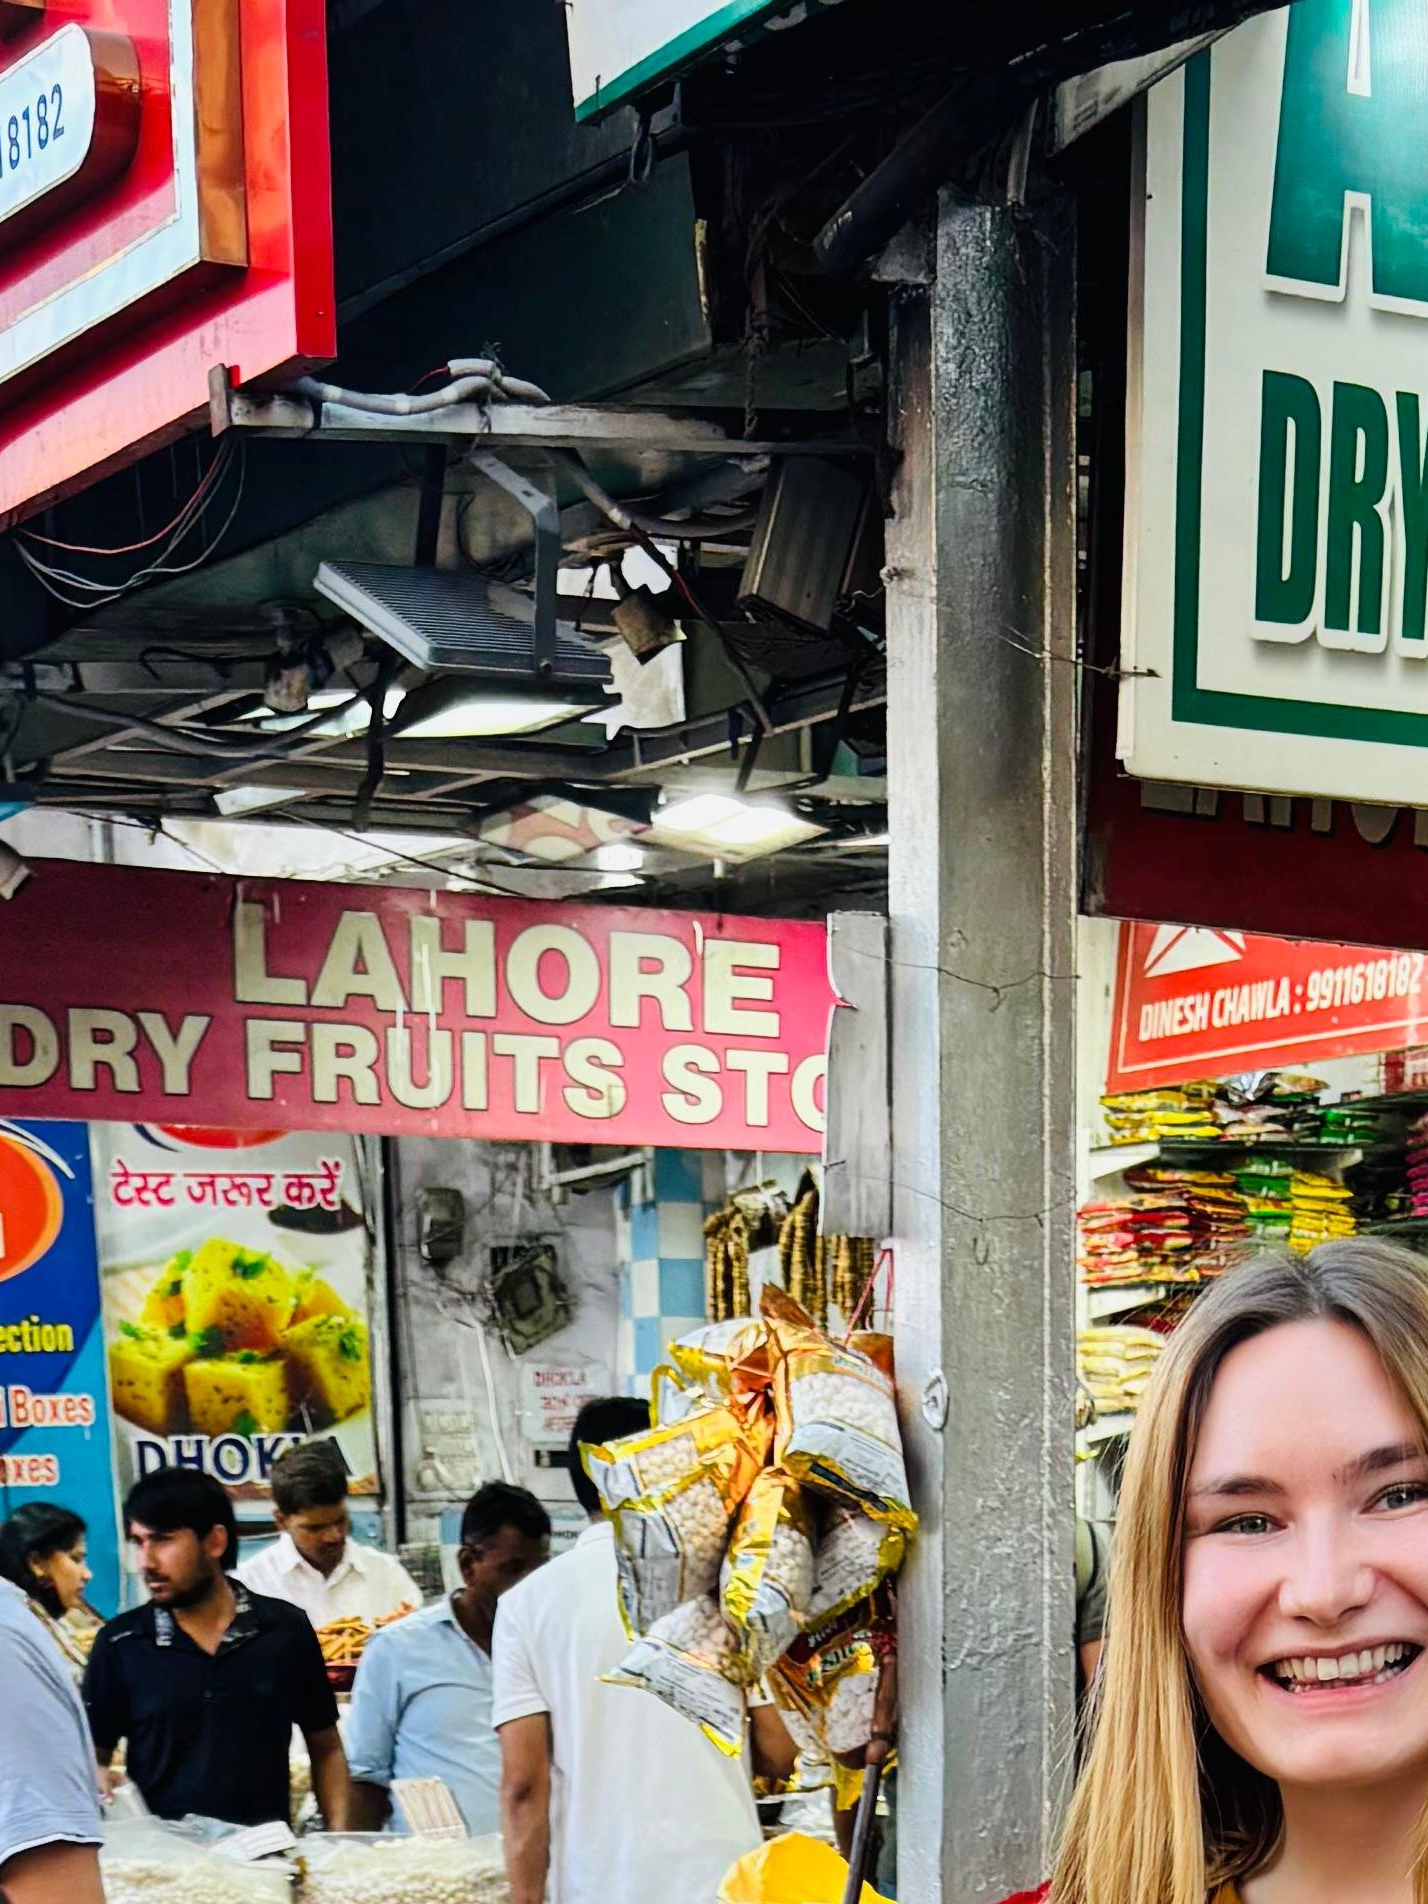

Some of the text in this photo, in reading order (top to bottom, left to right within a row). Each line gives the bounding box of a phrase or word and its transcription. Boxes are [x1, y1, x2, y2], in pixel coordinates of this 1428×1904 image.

[233, 902, 781, 1038] LAHORE
[1138, 991, 1210, 1042] DINESH
[1211, 974, 1290, 1026] CHAWLA
[1305, 954, 1424, 1010] 9911618182
[244, 1017, 626, 1120] FRUITS
[110, 1156, 342, 1210] टेस्ट जरूर करें
[8, 1385, 95, 1427] Boxes
